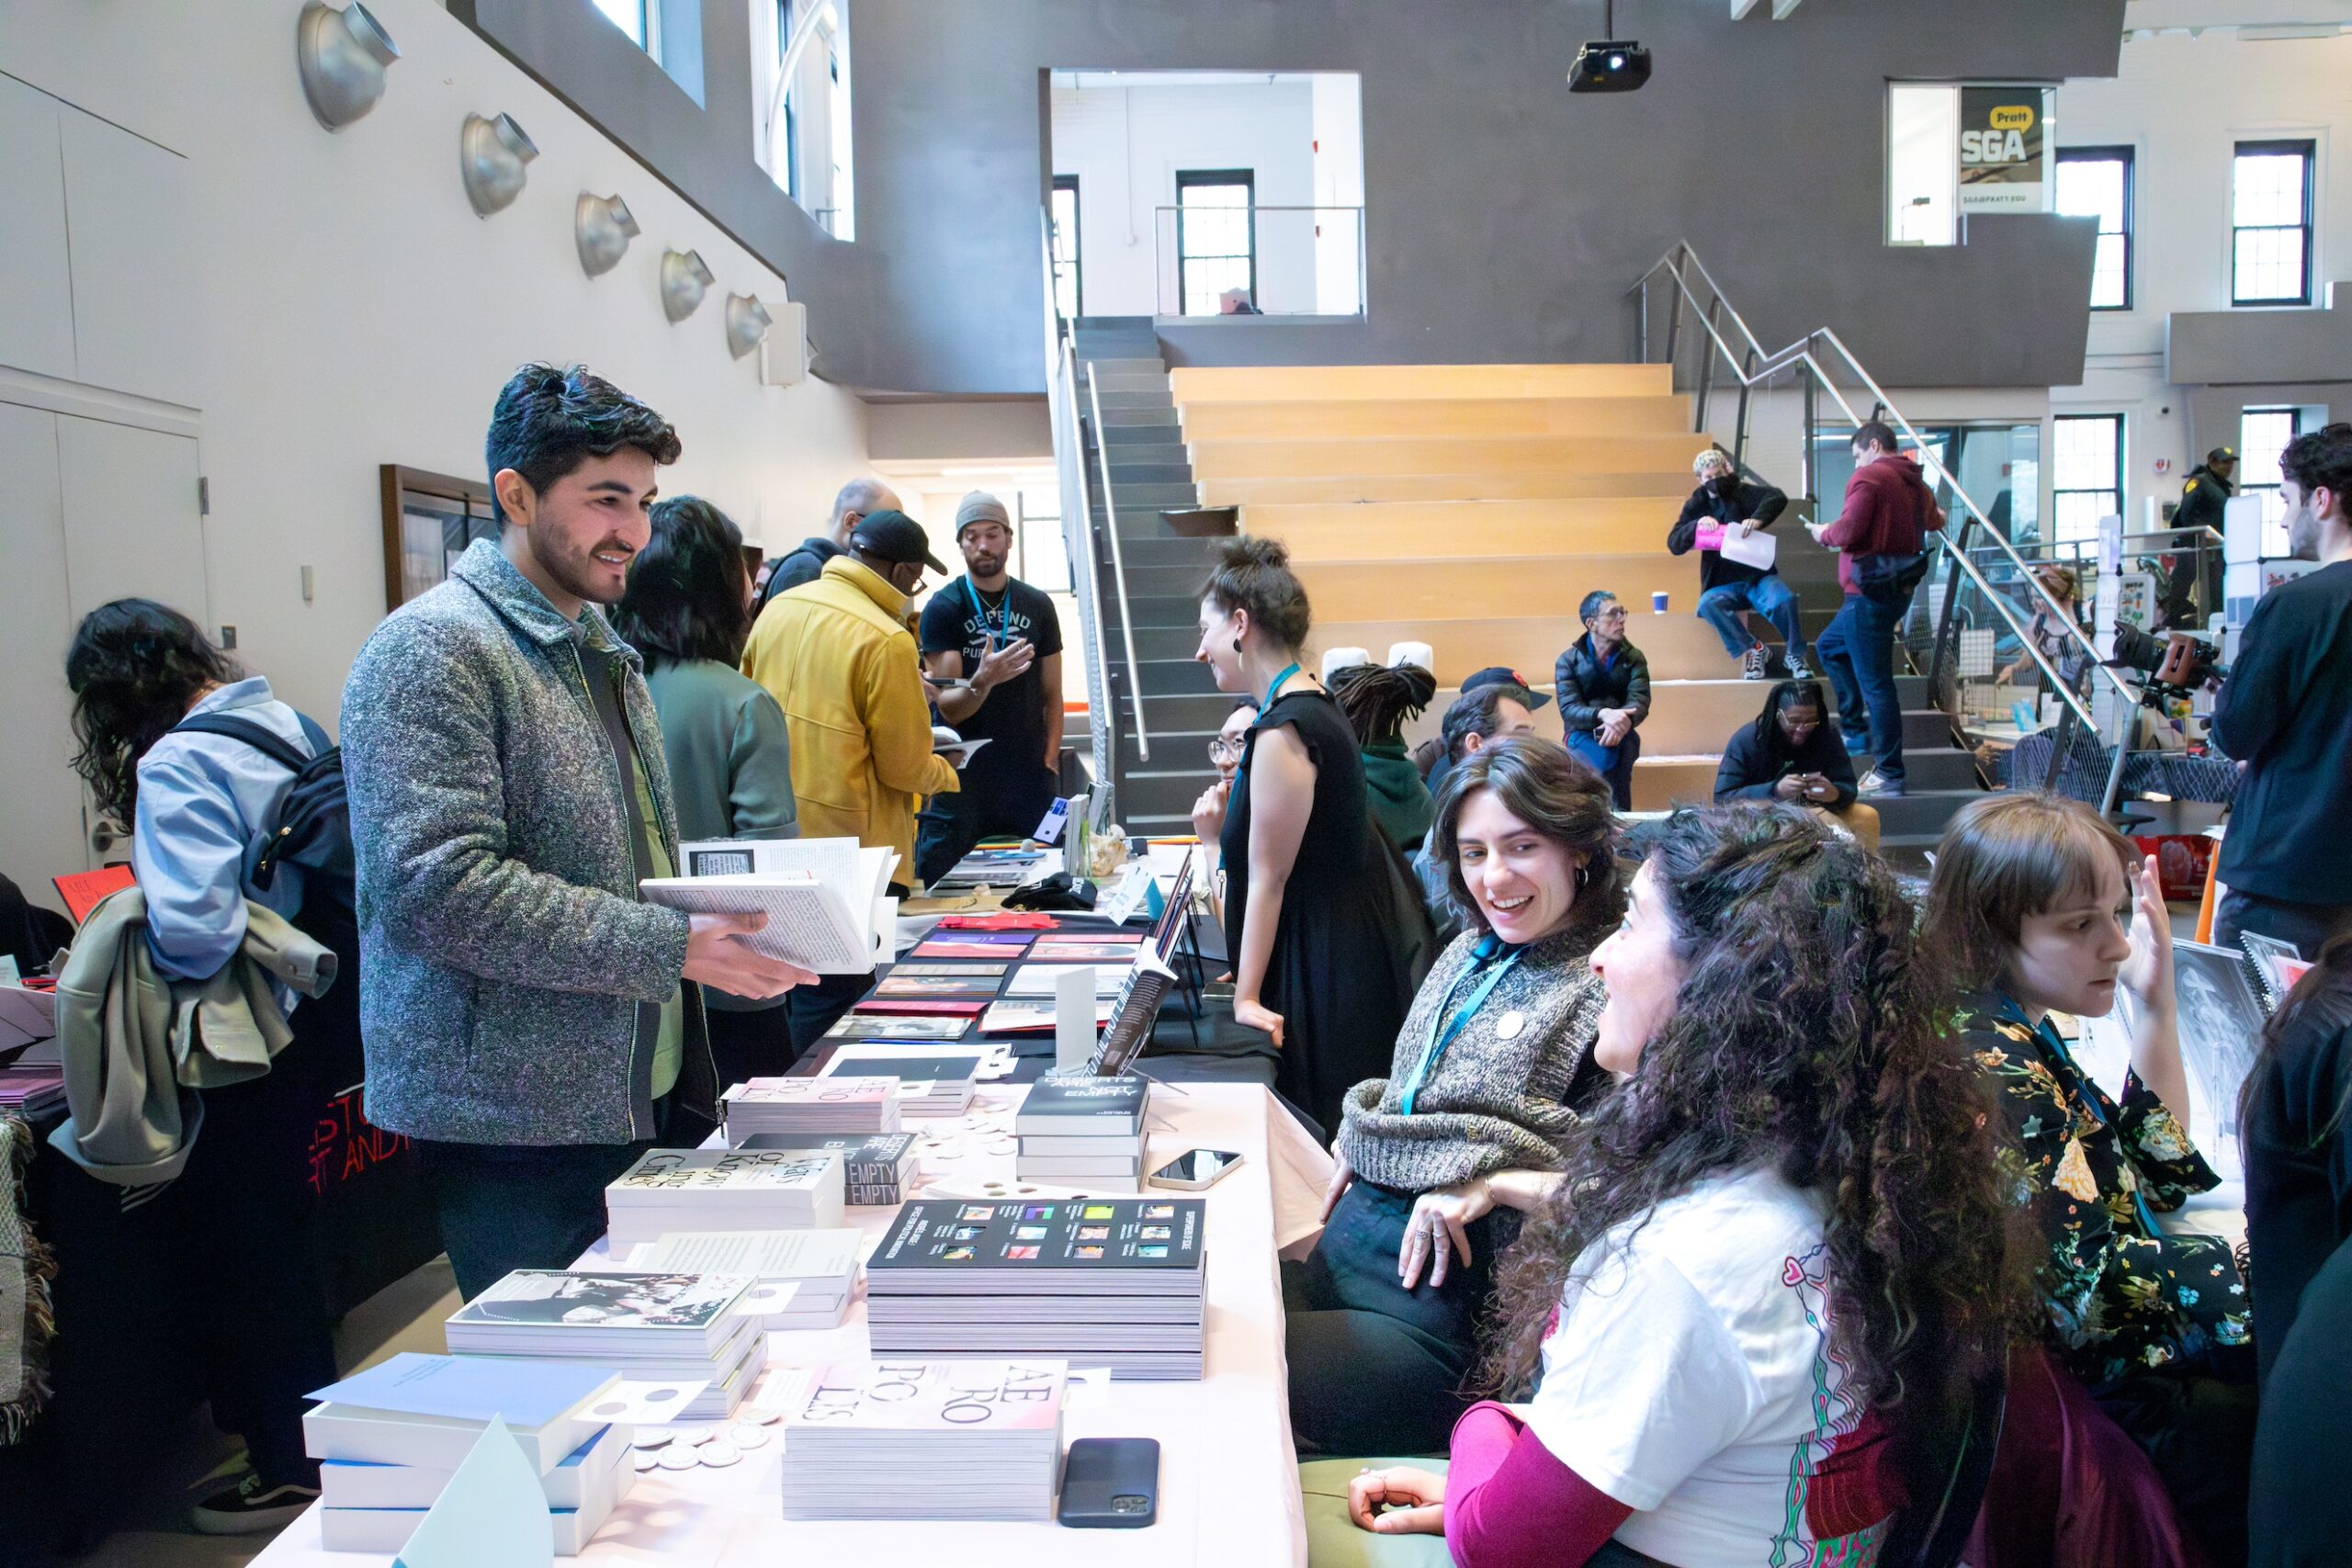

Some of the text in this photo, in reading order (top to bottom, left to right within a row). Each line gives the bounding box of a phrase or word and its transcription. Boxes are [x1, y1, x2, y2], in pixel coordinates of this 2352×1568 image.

[1996, 112, 2028, 122] Pratt
[1962, 130, 2027, 163] SGA
[964, 610, 1031, 634] DEFEND
[1064, 1089, 1138, 1097] EMPTY
[624, 1154, 686, 1187] Cities
[699, 1153, 761, 1188] Know
[849, 1163, 895, 1184] EMPTY
[852, 1184, 898, 1205] EMPTY
[941, 1385, 1000, 1424] RO
